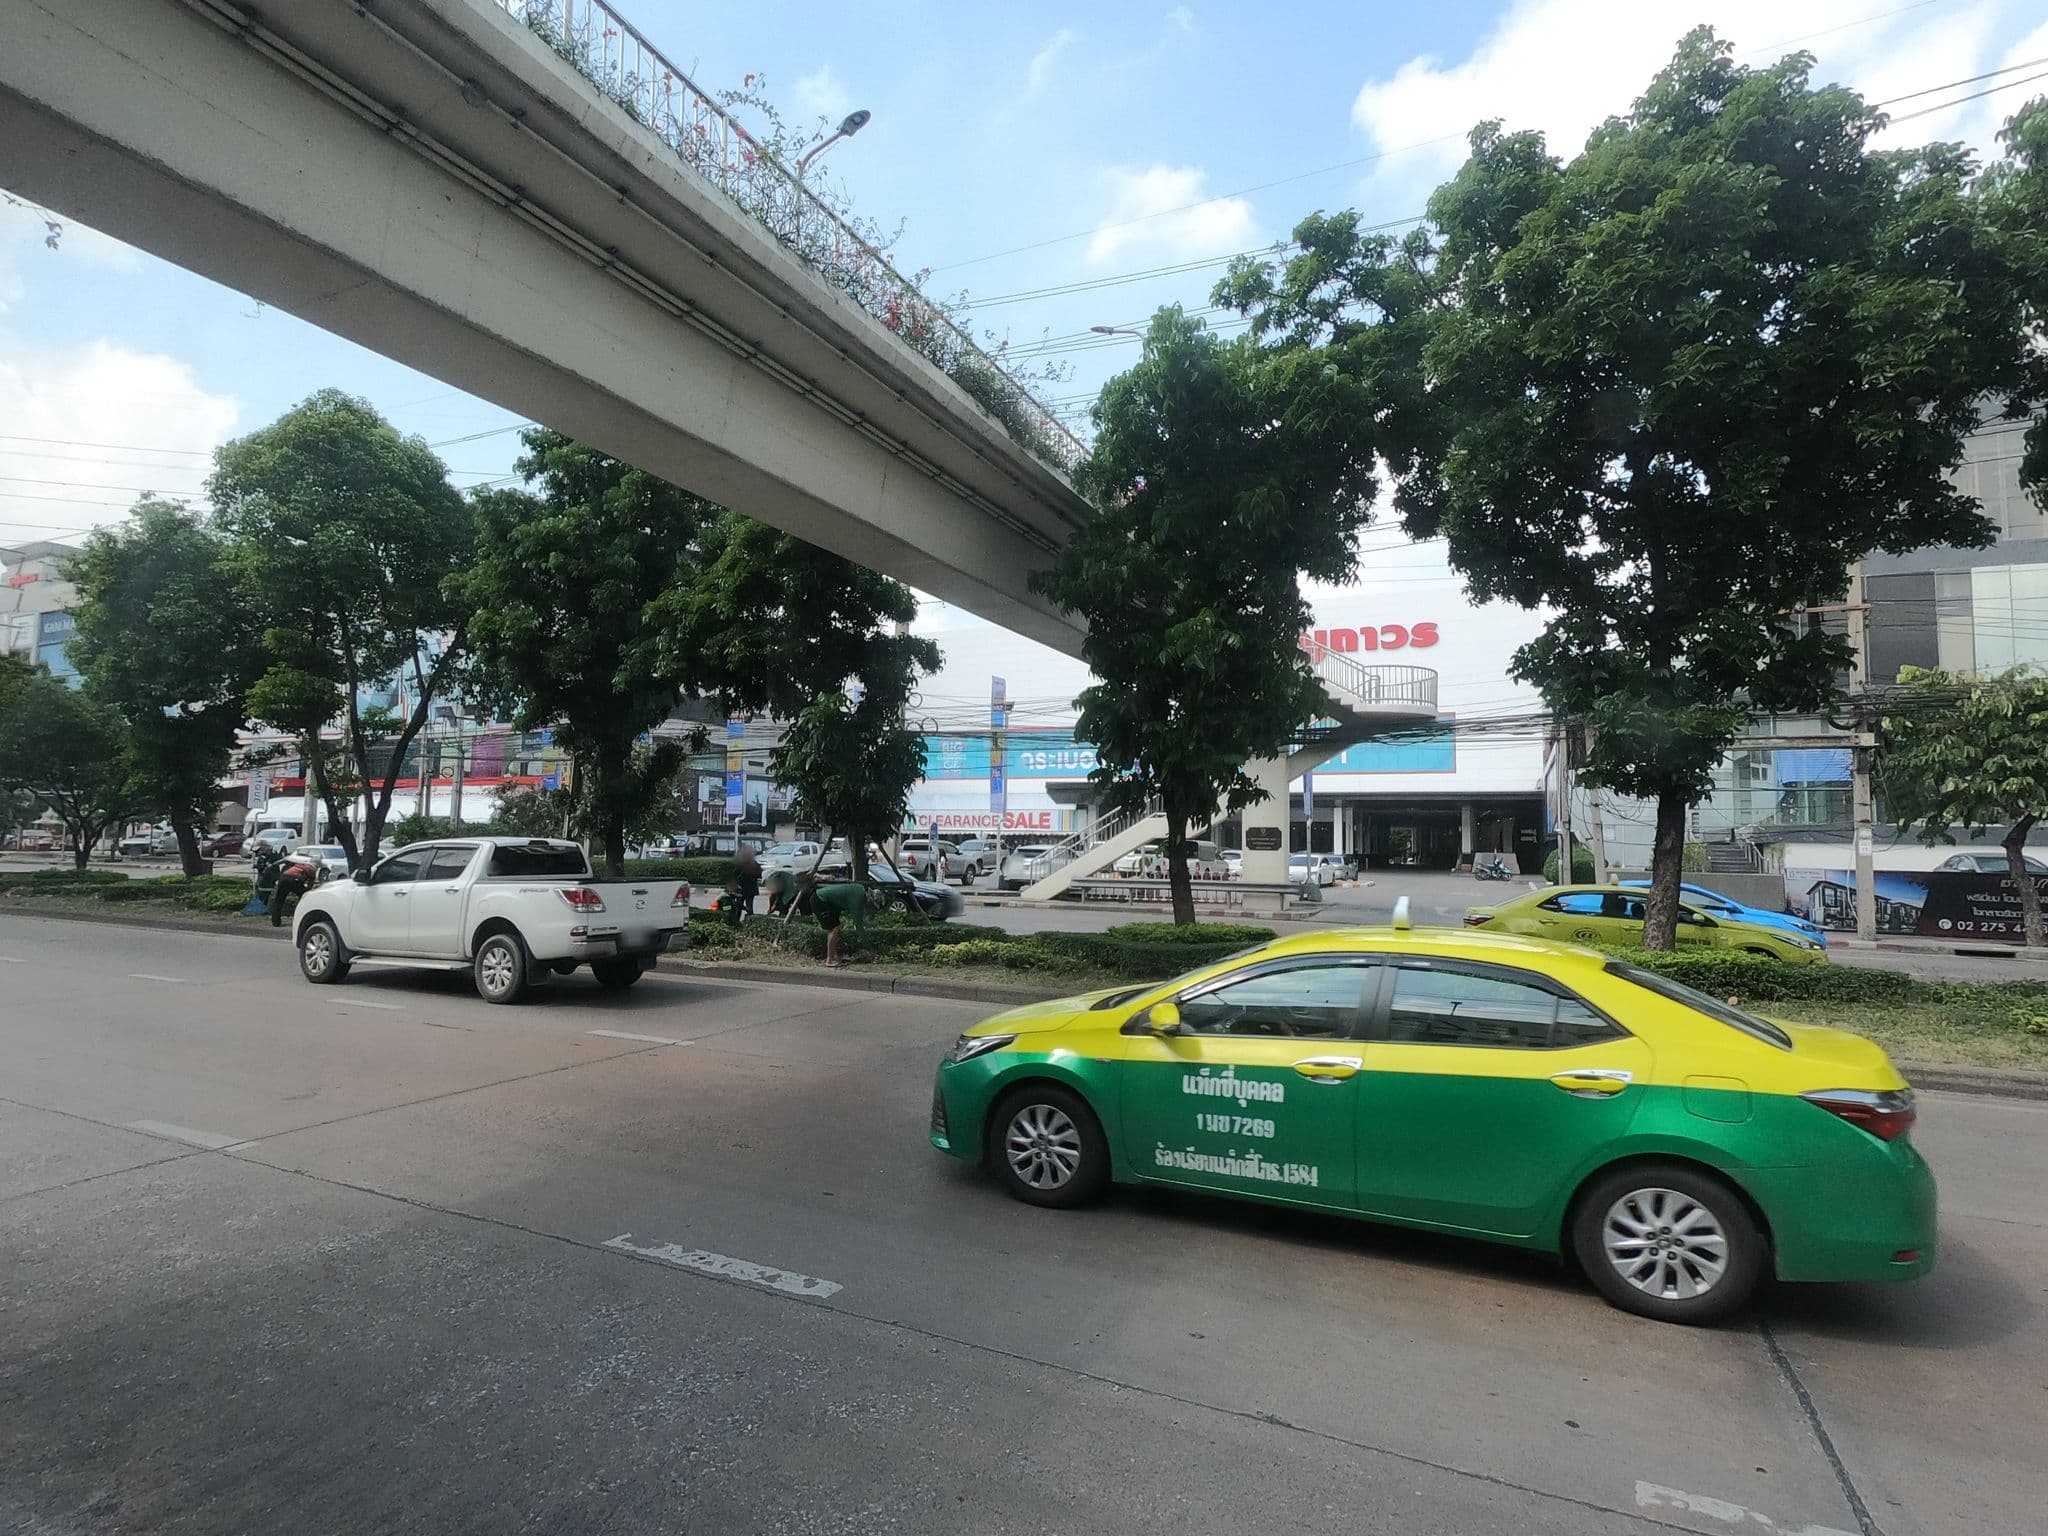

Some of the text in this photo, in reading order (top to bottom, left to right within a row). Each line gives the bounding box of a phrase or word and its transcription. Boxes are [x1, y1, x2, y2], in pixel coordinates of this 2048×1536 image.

[918, 811, 1051, 829] CLEARANCE SALE
[1957, 921, 1975, 931] 02
[1980, 922, 2007, 933] 275
[1231, 1116, 1276, 1139] 7269
